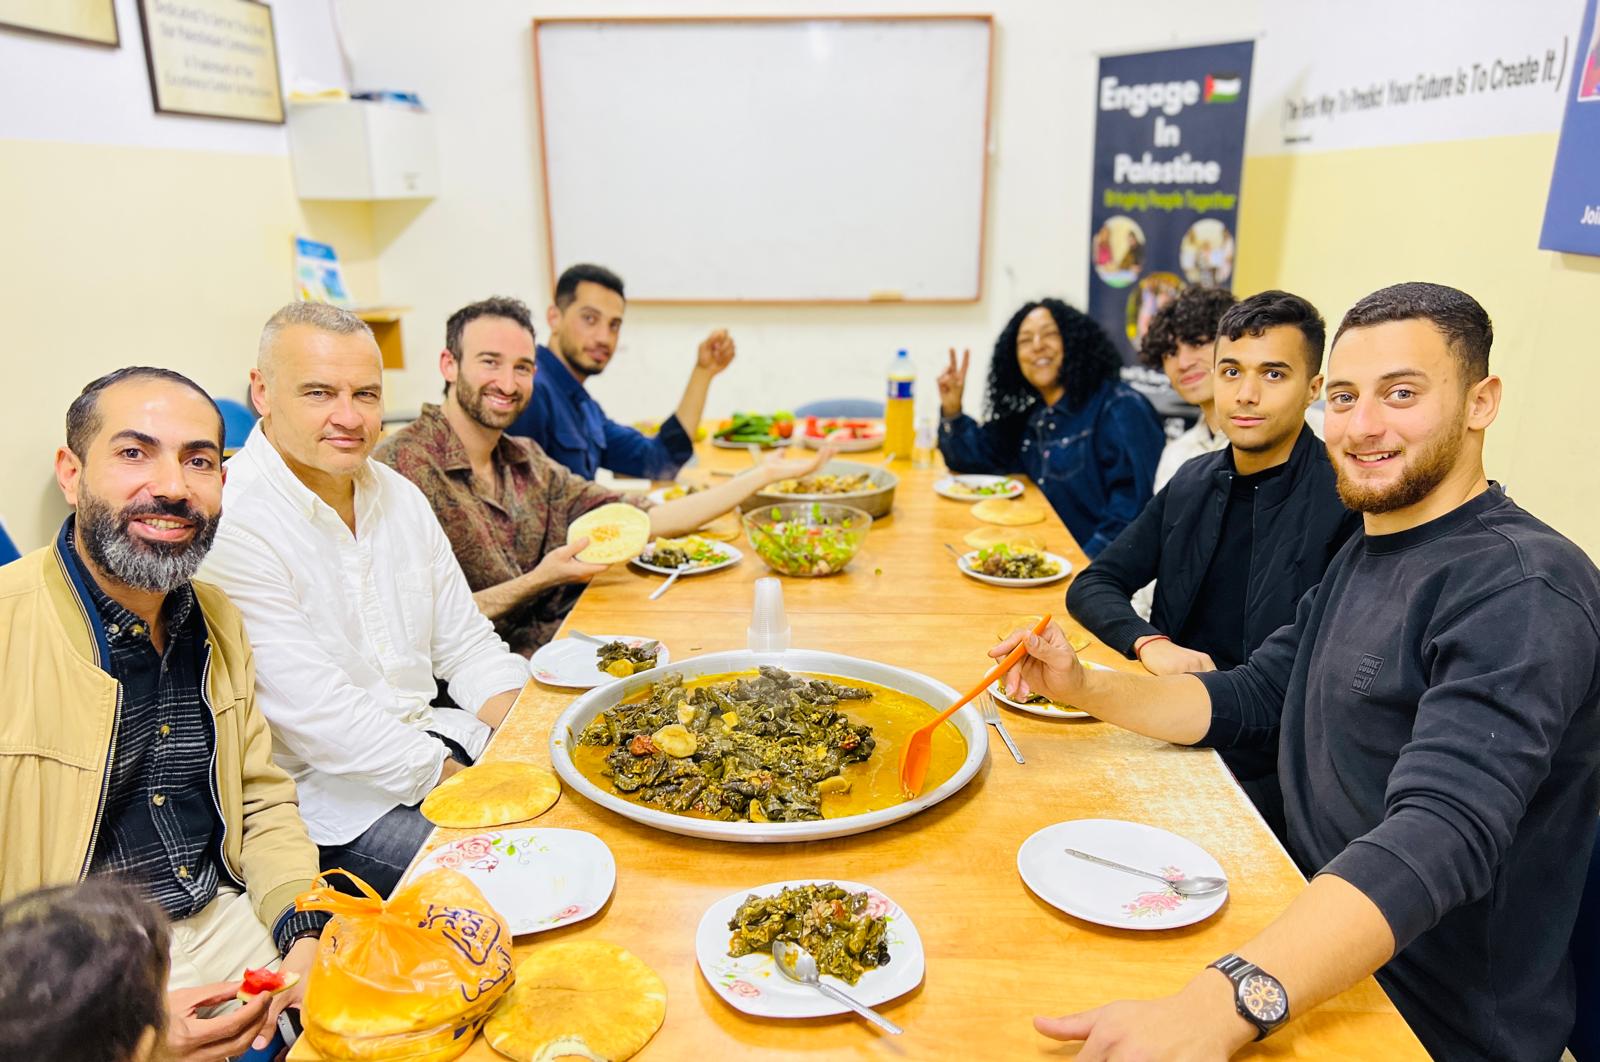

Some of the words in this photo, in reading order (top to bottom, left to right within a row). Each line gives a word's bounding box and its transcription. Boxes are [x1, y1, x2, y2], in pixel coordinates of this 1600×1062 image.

[1101, 75, 1200, 118] Engage
[1387, 77, 1413, 106] Your
[1414, 71, 1452, 101] Future
[1455, 66, 1468, 96] Is
[1470, 63, 1489, 94] To
[1490, 56, 1540, 91] Create
[1154, 116, 1181, 147] In
[1113, 151, 1221, 184] Palestine
[1580, 205, 1600, 225] Joi
